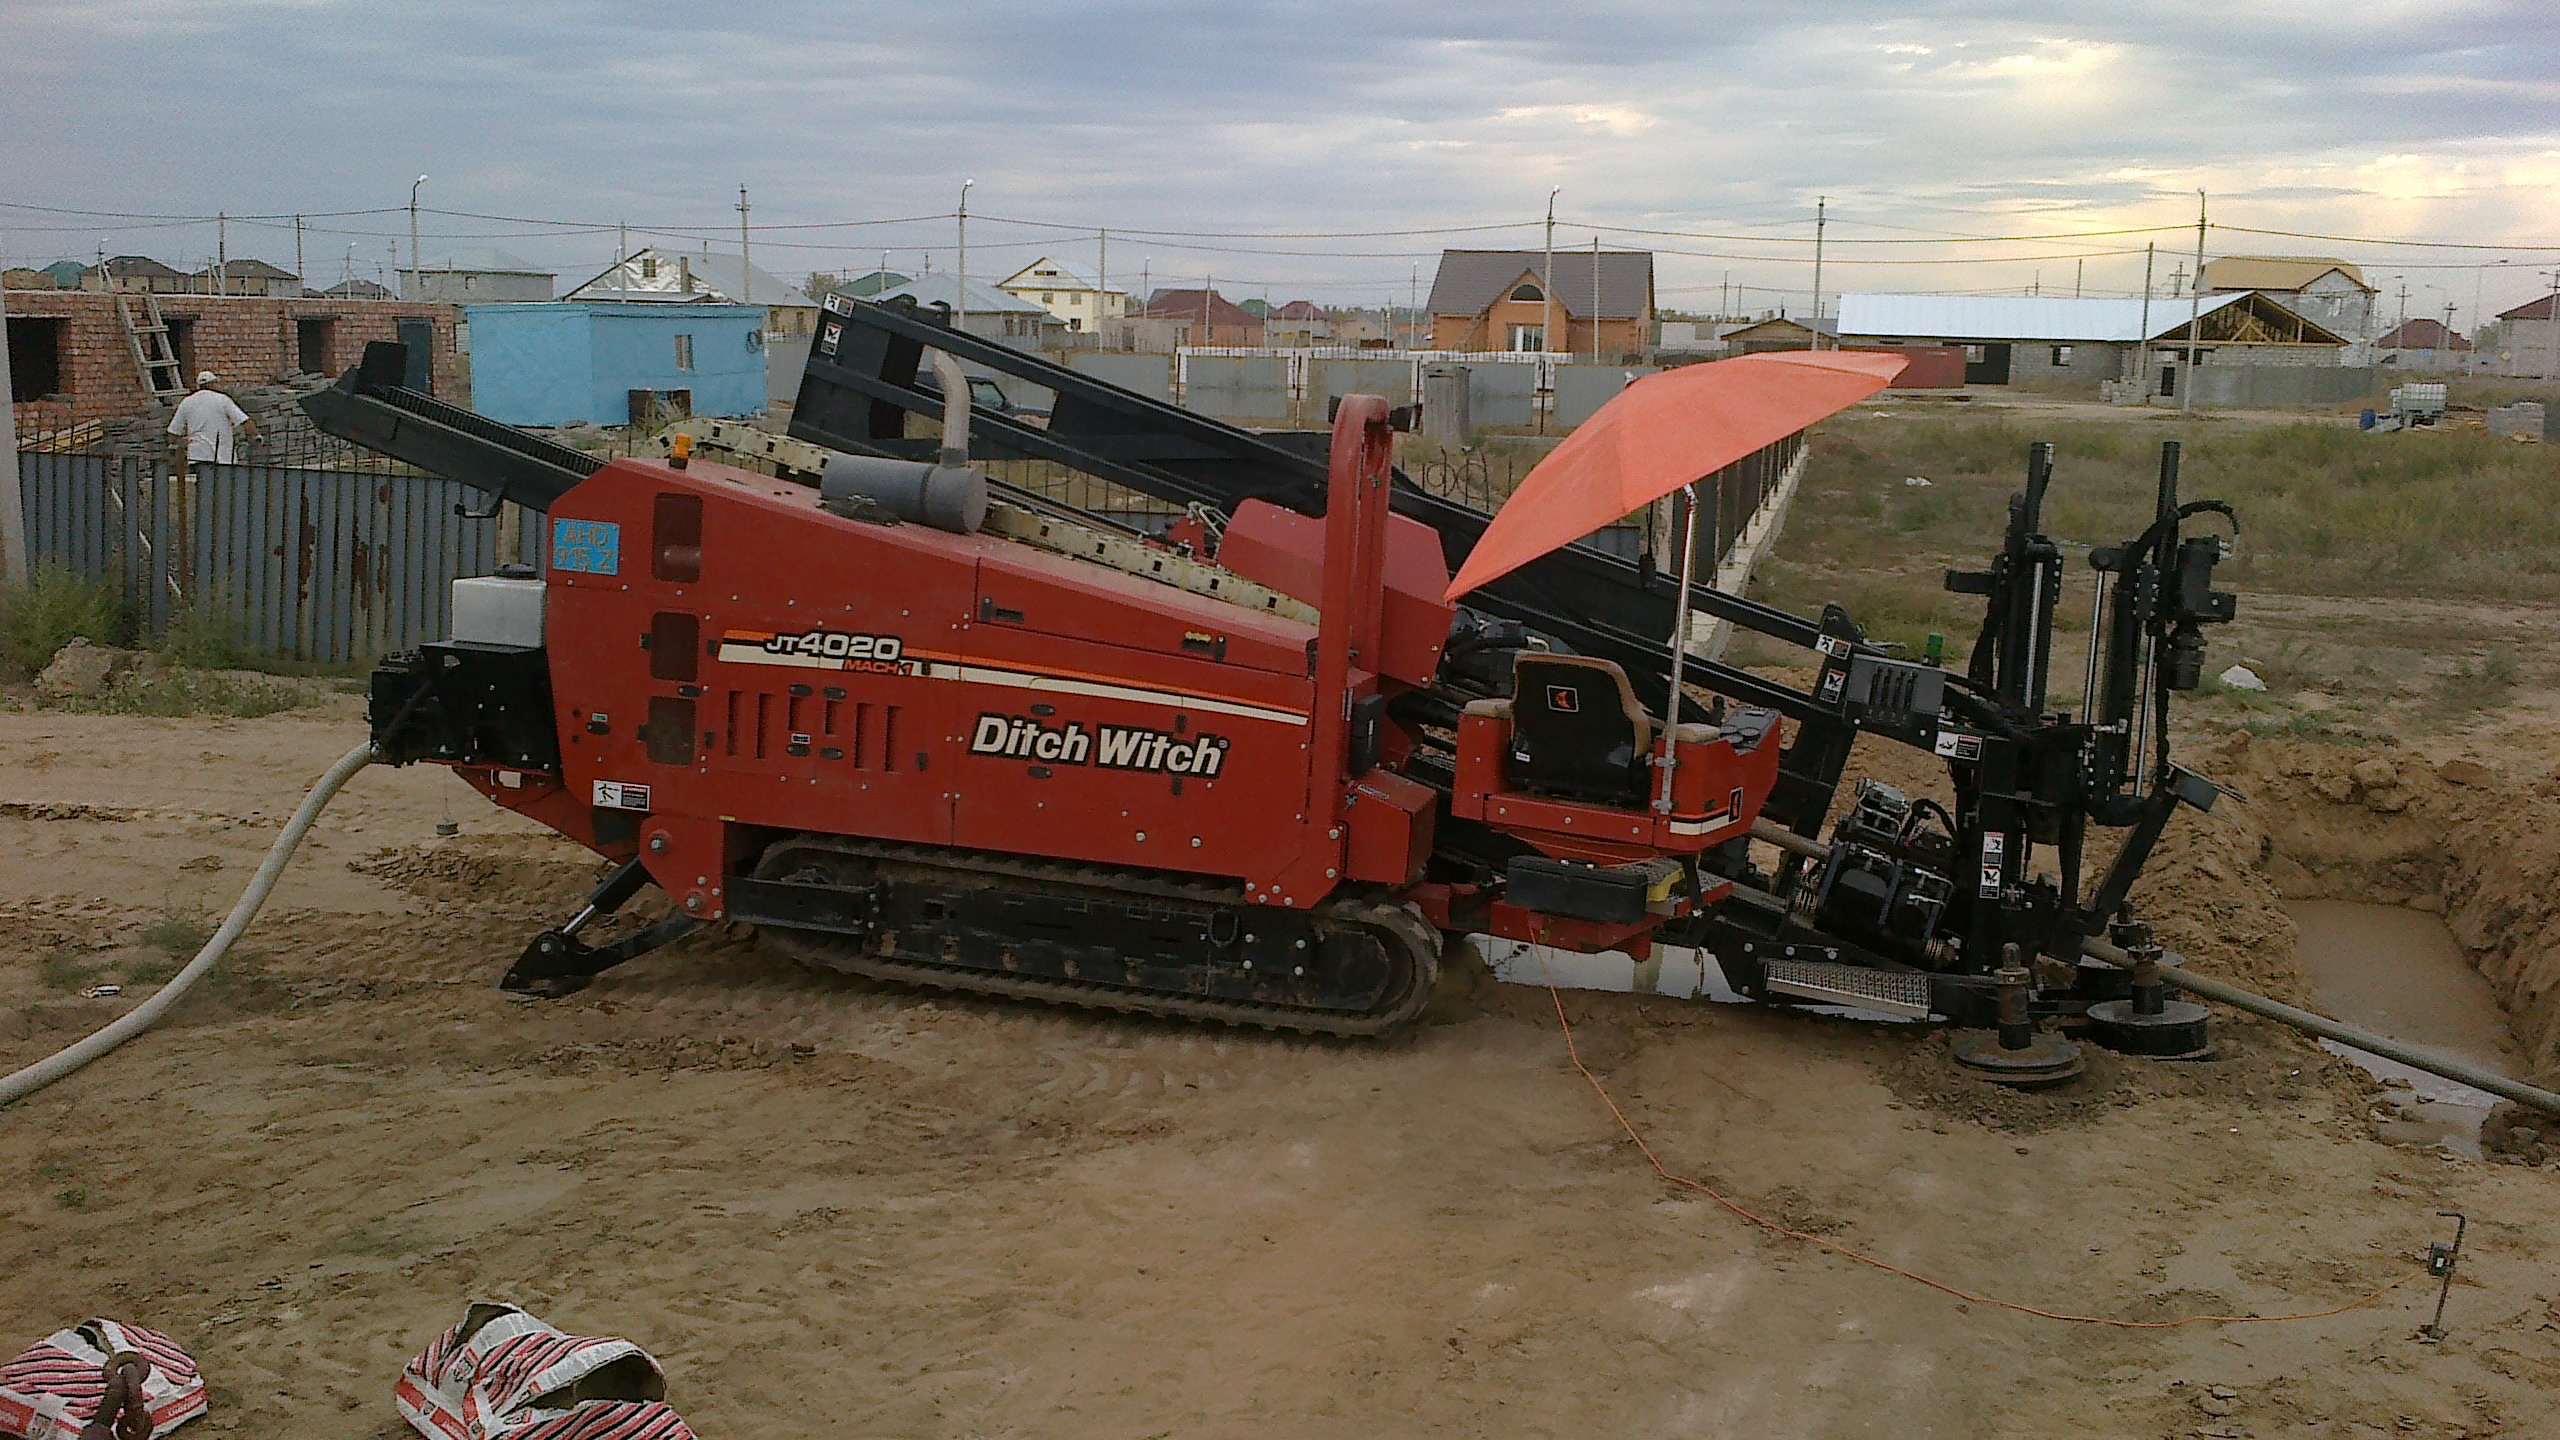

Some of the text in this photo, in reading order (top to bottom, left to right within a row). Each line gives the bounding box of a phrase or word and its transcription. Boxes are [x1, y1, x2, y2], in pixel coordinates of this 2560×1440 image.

[766, 632, 901, 660] JT4020
[843, 659, 912, 676] MACH 1
[971, 715, 1223, 775] Ditch Witch
